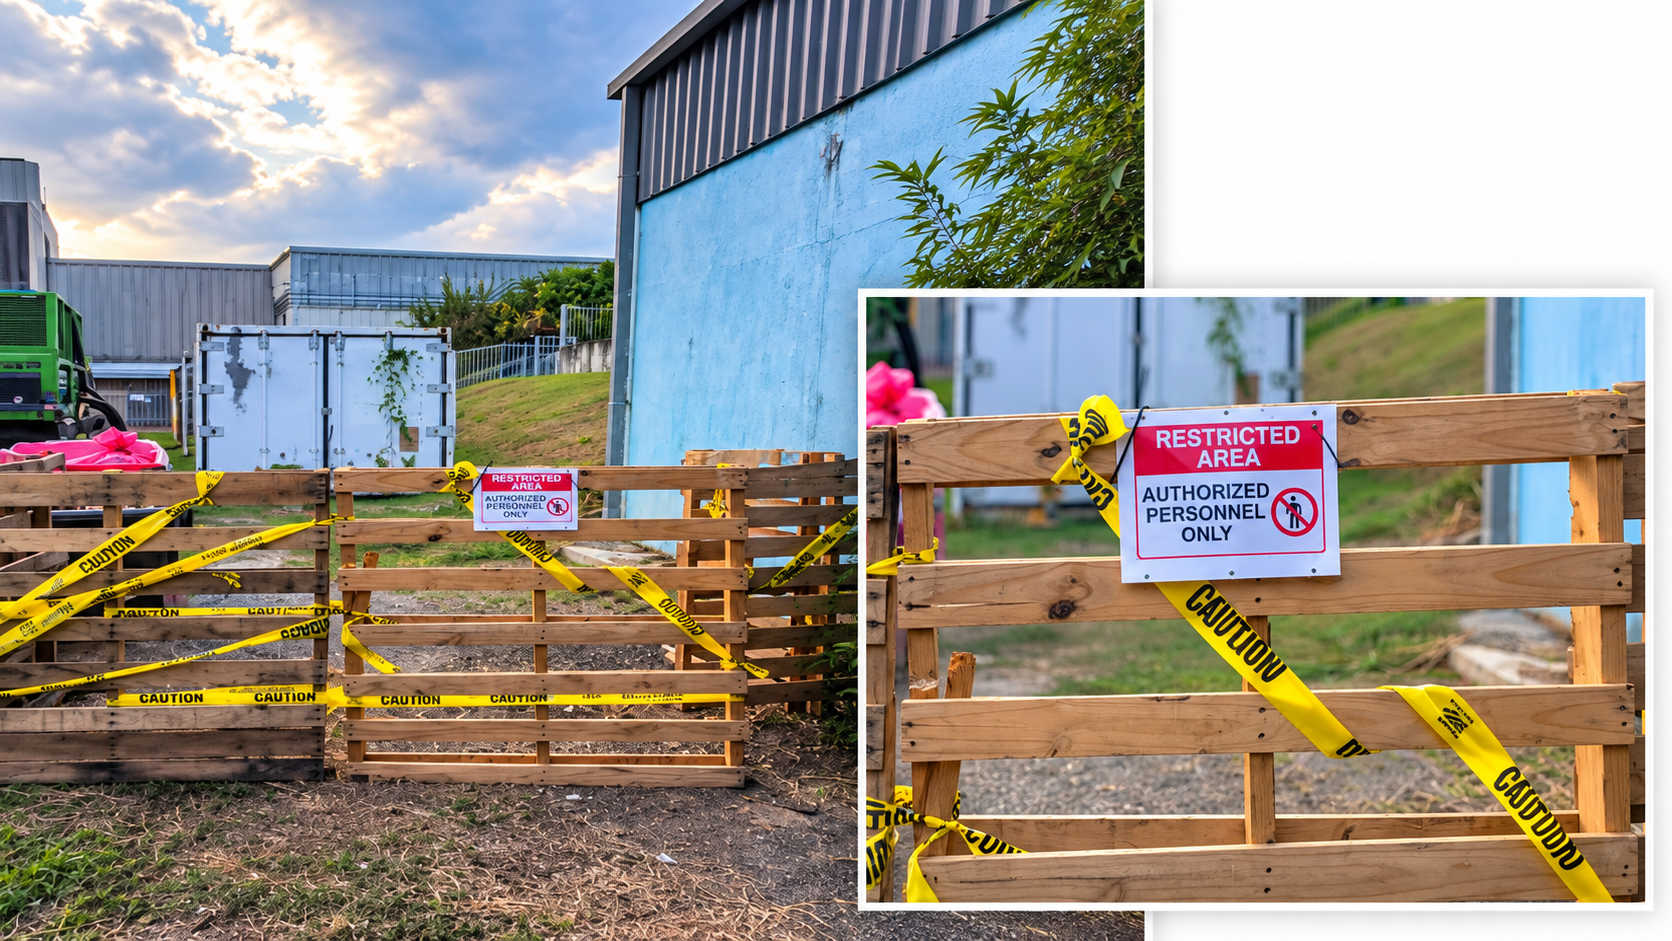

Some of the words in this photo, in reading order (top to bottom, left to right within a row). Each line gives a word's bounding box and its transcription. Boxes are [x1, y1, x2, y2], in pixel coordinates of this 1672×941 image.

[1155, 425, 1301, 449] RESTRICTED
[1196, 448, 1262, 469] AREA
[491, 474, 562, 483] RESTRICTED
[1142, 482, 1270, 503] AUTHORIZED
[486, 502, 544, 510] PERSONNEL
[1146, 503, 1266, 523] PERSONNEL
[503, 510, 528, 518] ONLY
[1181, 525, 1233, 542] ONLY
[139, 693, 204, 703] CAUTION
[254, 692, 316, 702] CAUTION
[381, 695, 441, 706] CAUTION
[490, 694, 548, 704] CAUTION
